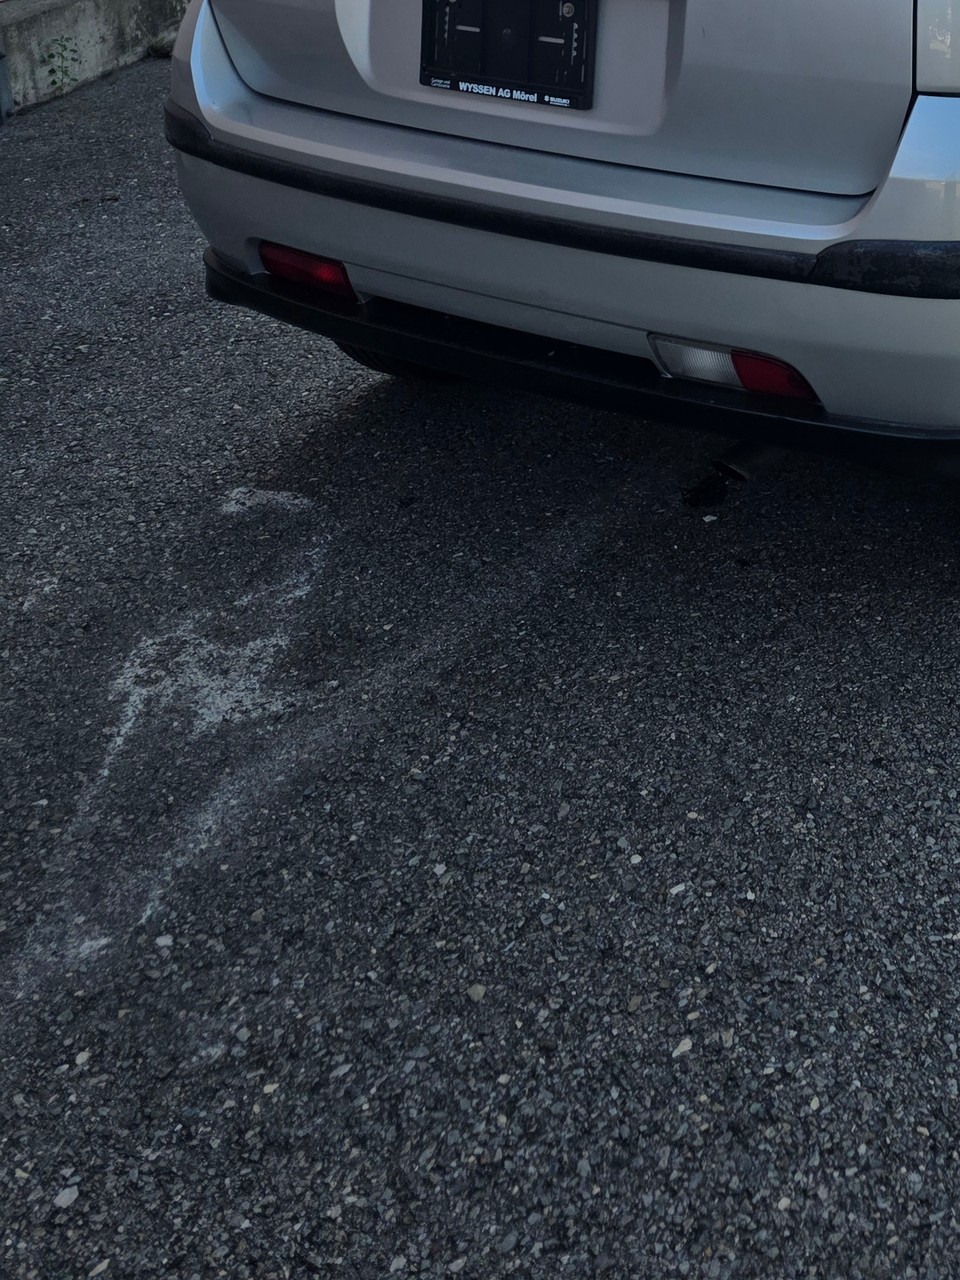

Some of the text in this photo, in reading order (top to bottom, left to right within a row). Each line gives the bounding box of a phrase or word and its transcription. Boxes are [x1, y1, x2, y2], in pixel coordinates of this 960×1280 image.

[459, 81, 496, 96] WYSSEN
[497, 88, 511, 99] AG
[512, 89, 537, 103] Mörel
